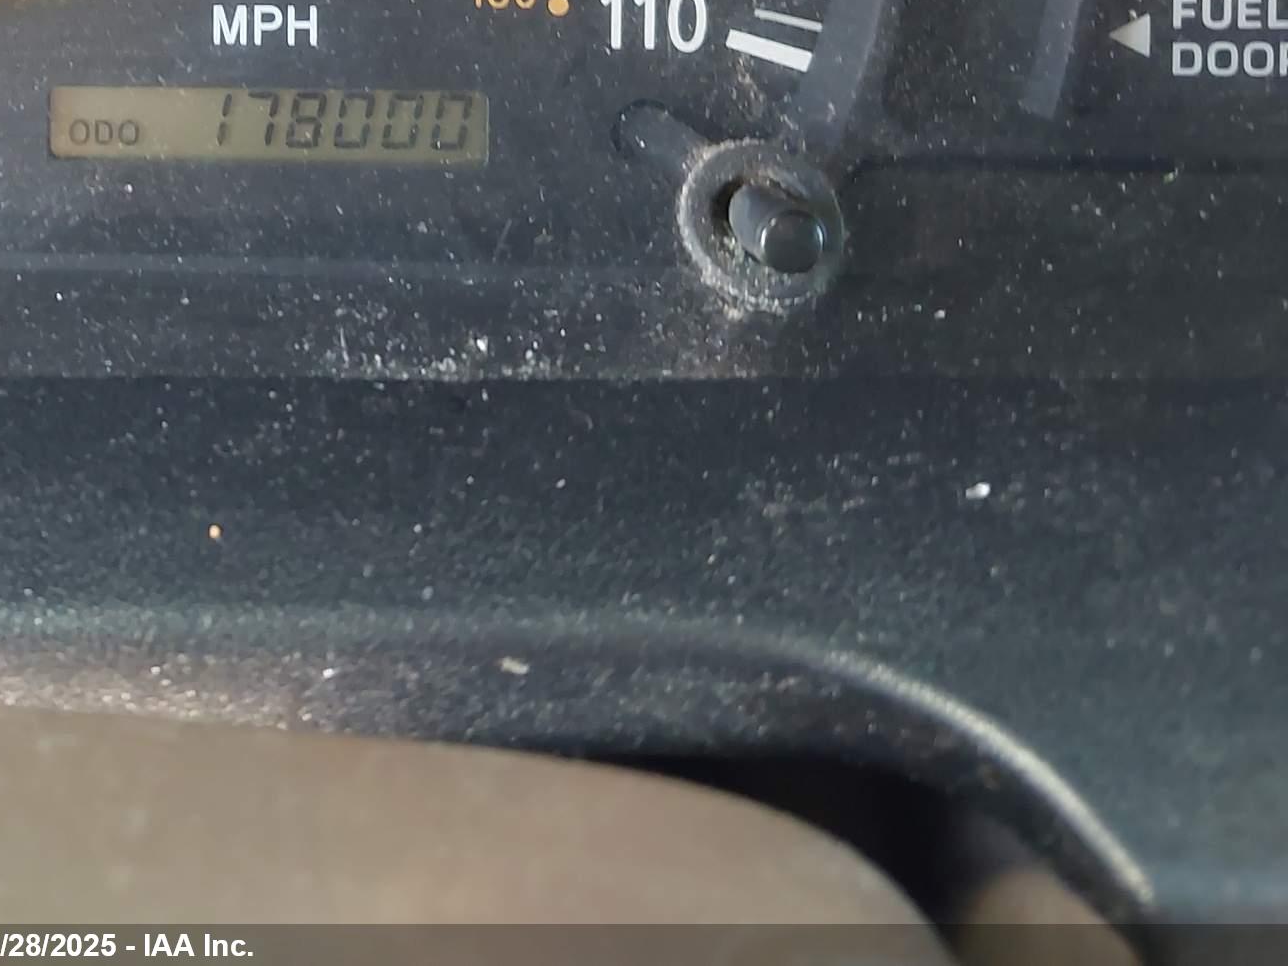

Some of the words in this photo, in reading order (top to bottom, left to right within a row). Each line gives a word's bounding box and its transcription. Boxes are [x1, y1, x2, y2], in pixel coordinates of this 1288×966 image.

[213, 4, 318, 47] MPH
[69, 119, 140, 146] ODO
[216, 91, 473, 150] 178000
